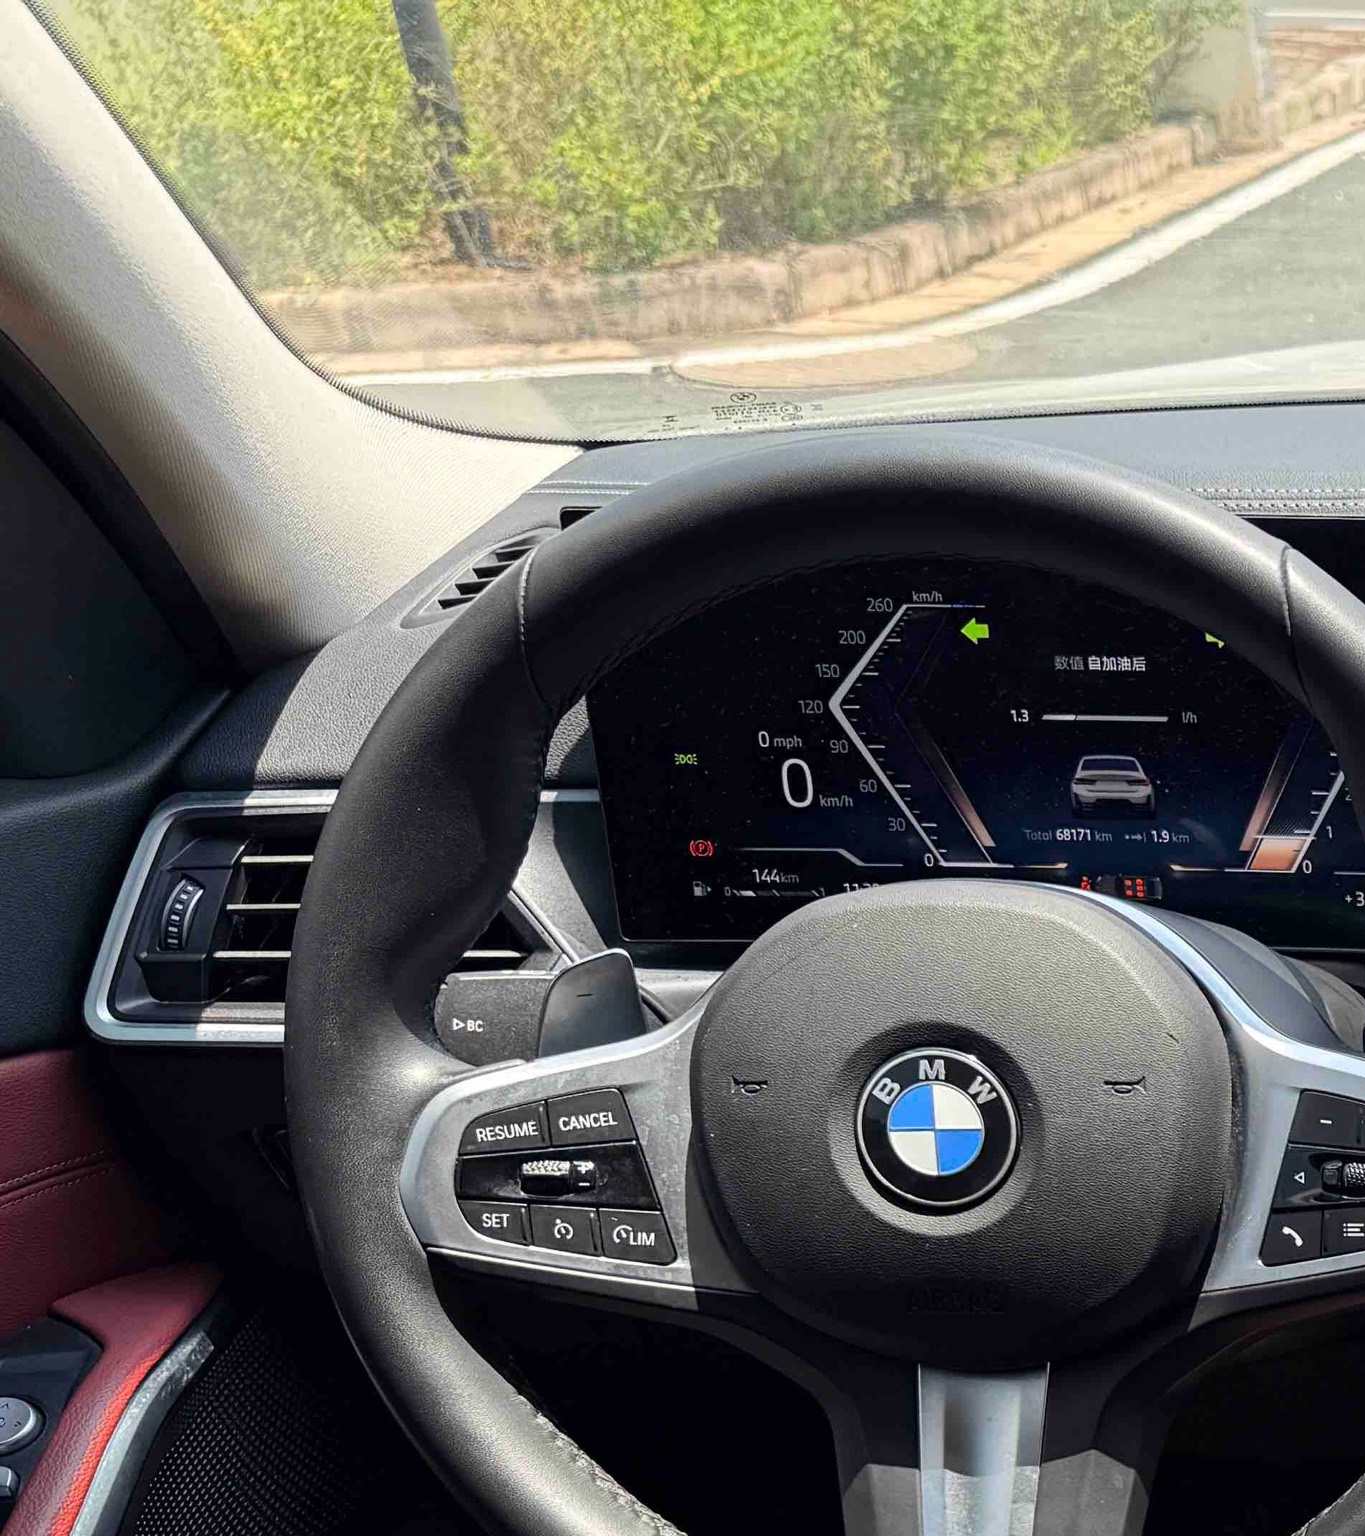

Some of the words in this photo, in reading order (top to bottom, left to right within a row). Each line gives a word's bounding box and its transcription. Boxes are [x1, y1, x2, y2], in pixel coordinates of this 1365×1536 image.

[912, 591, 943, 603] km/h
[866, 598, 893, 612] 260
[838, 630, 865, 645] 200
[1054, 655, 1085, 671] 数值
[1088, 655, 1146, 671] 自加油后
[815, 664, 840, 678] 150
[798, 700, 823, 714] 120
[1010, 709, 1029, 723] 1.3
[758, 731, 770, 747] 0
[773, 735, 802, 749] mph
[830, 740, 849, 753] 90
[781, 758, 813, 808] 0
[819, 795, 853, 808] km/h
[859, 779, 877, 793] 60
[888, 818, 905, 832] 30
[1024, 829, 1052, 841] Total
[1056, 829, 1091, 841] 68171
[1095, 831, 1113, 842] km
[1151, 830, 1170, 843] 1.9
[1172, 832, 1190, 843] km
[1326, 826, 1333, 839] 1
[924, 853, 934, 867] 0
[1302, 860, 1312, 874] 0
[467, 1020, 484, 1032] BC
[872, 1059, 997, 1106] BMW
[558, 1112, 618, 1132] CANCEL
[475, 1121, 539, 1142] RESUME
[482, 1213, 509, 1228] SET
[629, 1231, 655, 1246] LIM
